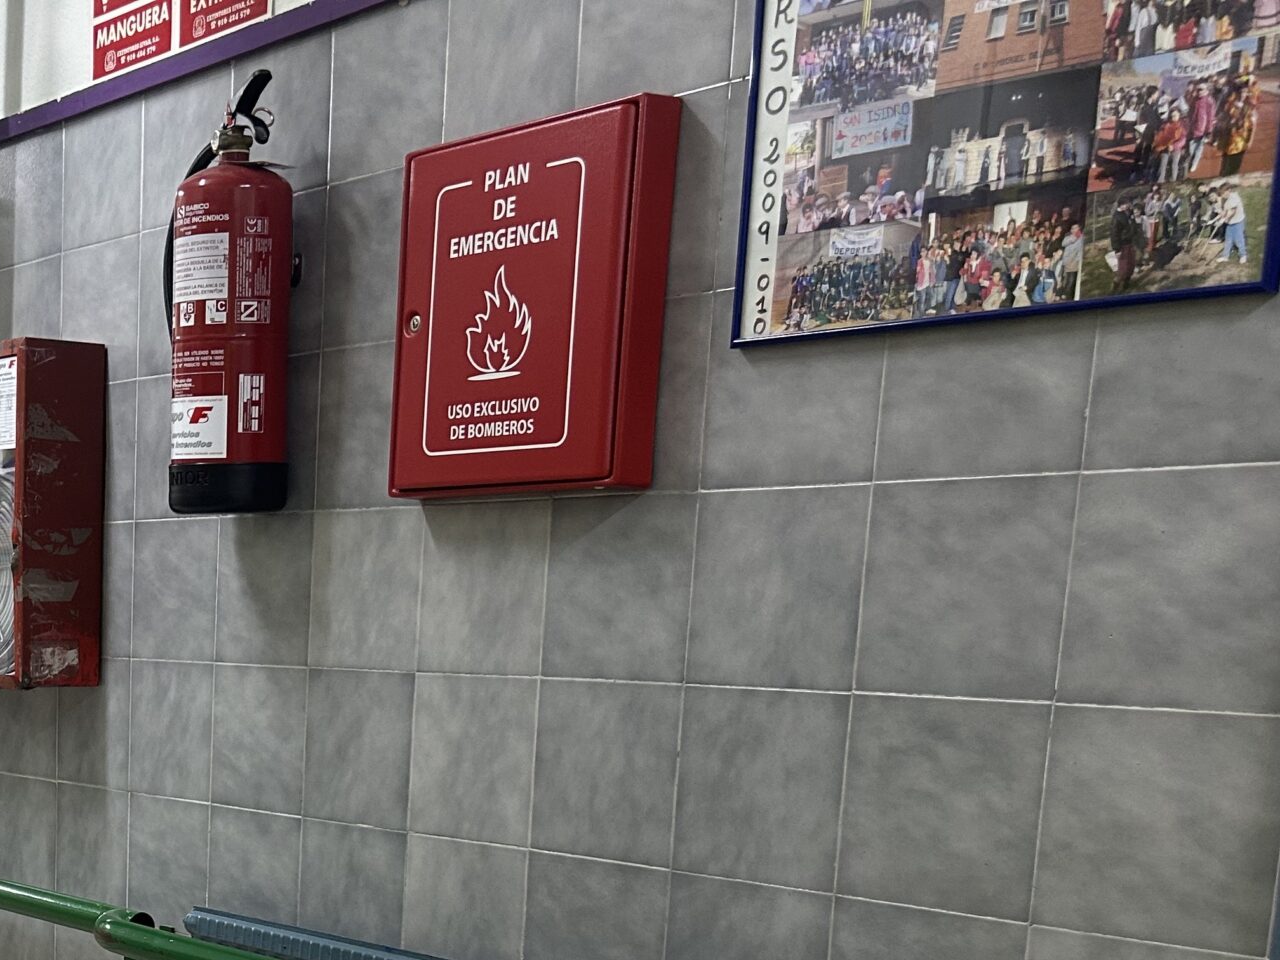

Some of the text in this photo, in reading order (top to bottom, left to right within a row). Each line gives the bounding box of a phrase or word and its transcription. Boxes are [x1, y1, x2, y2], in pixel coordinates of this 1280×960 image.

[96, 2, 169, 50] MANGUERA
[484, 162, 530, 192] PLAN
[192, 214, 230, 224] INCENDIOS
[492, 196, 516, 221] DE
[449, 218, 559, 259] EMERGENCIA
[187, 303, 194, 314] B
[217, 300, 226, 310] C
[8, 360, 16, 368] F
[447, 396, 540, 420] USO EXCLUSIVO
[450, 418, 534, 440] DE BOMBEROS
